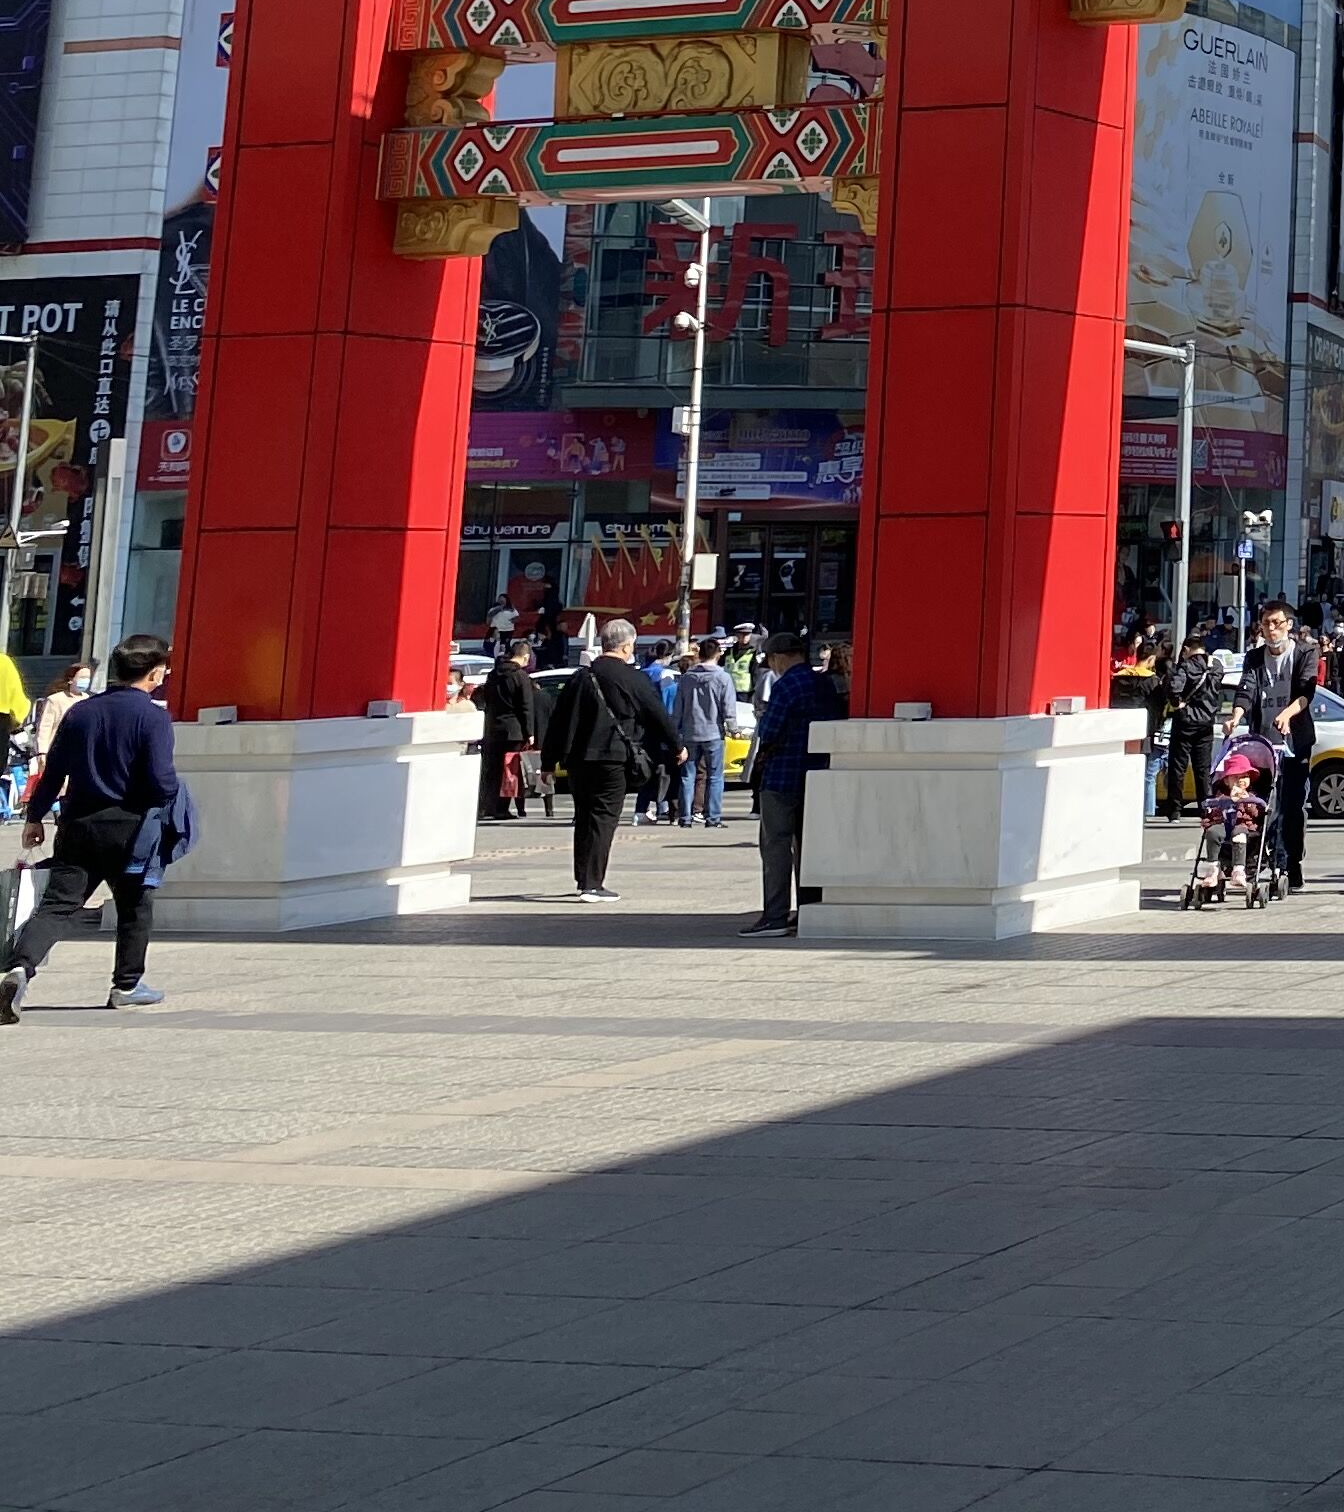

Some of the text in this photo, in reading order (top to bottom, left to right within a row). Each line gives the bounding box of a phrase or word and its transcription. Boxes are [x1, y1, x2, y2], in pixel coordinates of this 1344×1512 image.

[1183, 28, 1269, 73] GUERLAIN
[1190, 107, 1228, 130] ABEILLE
[171, 299, 189, 313] LE
[22, 302, 83, 334] POT
[464, 524, 550, 536] shu uemura
[605, 522, 632, 534] shu
